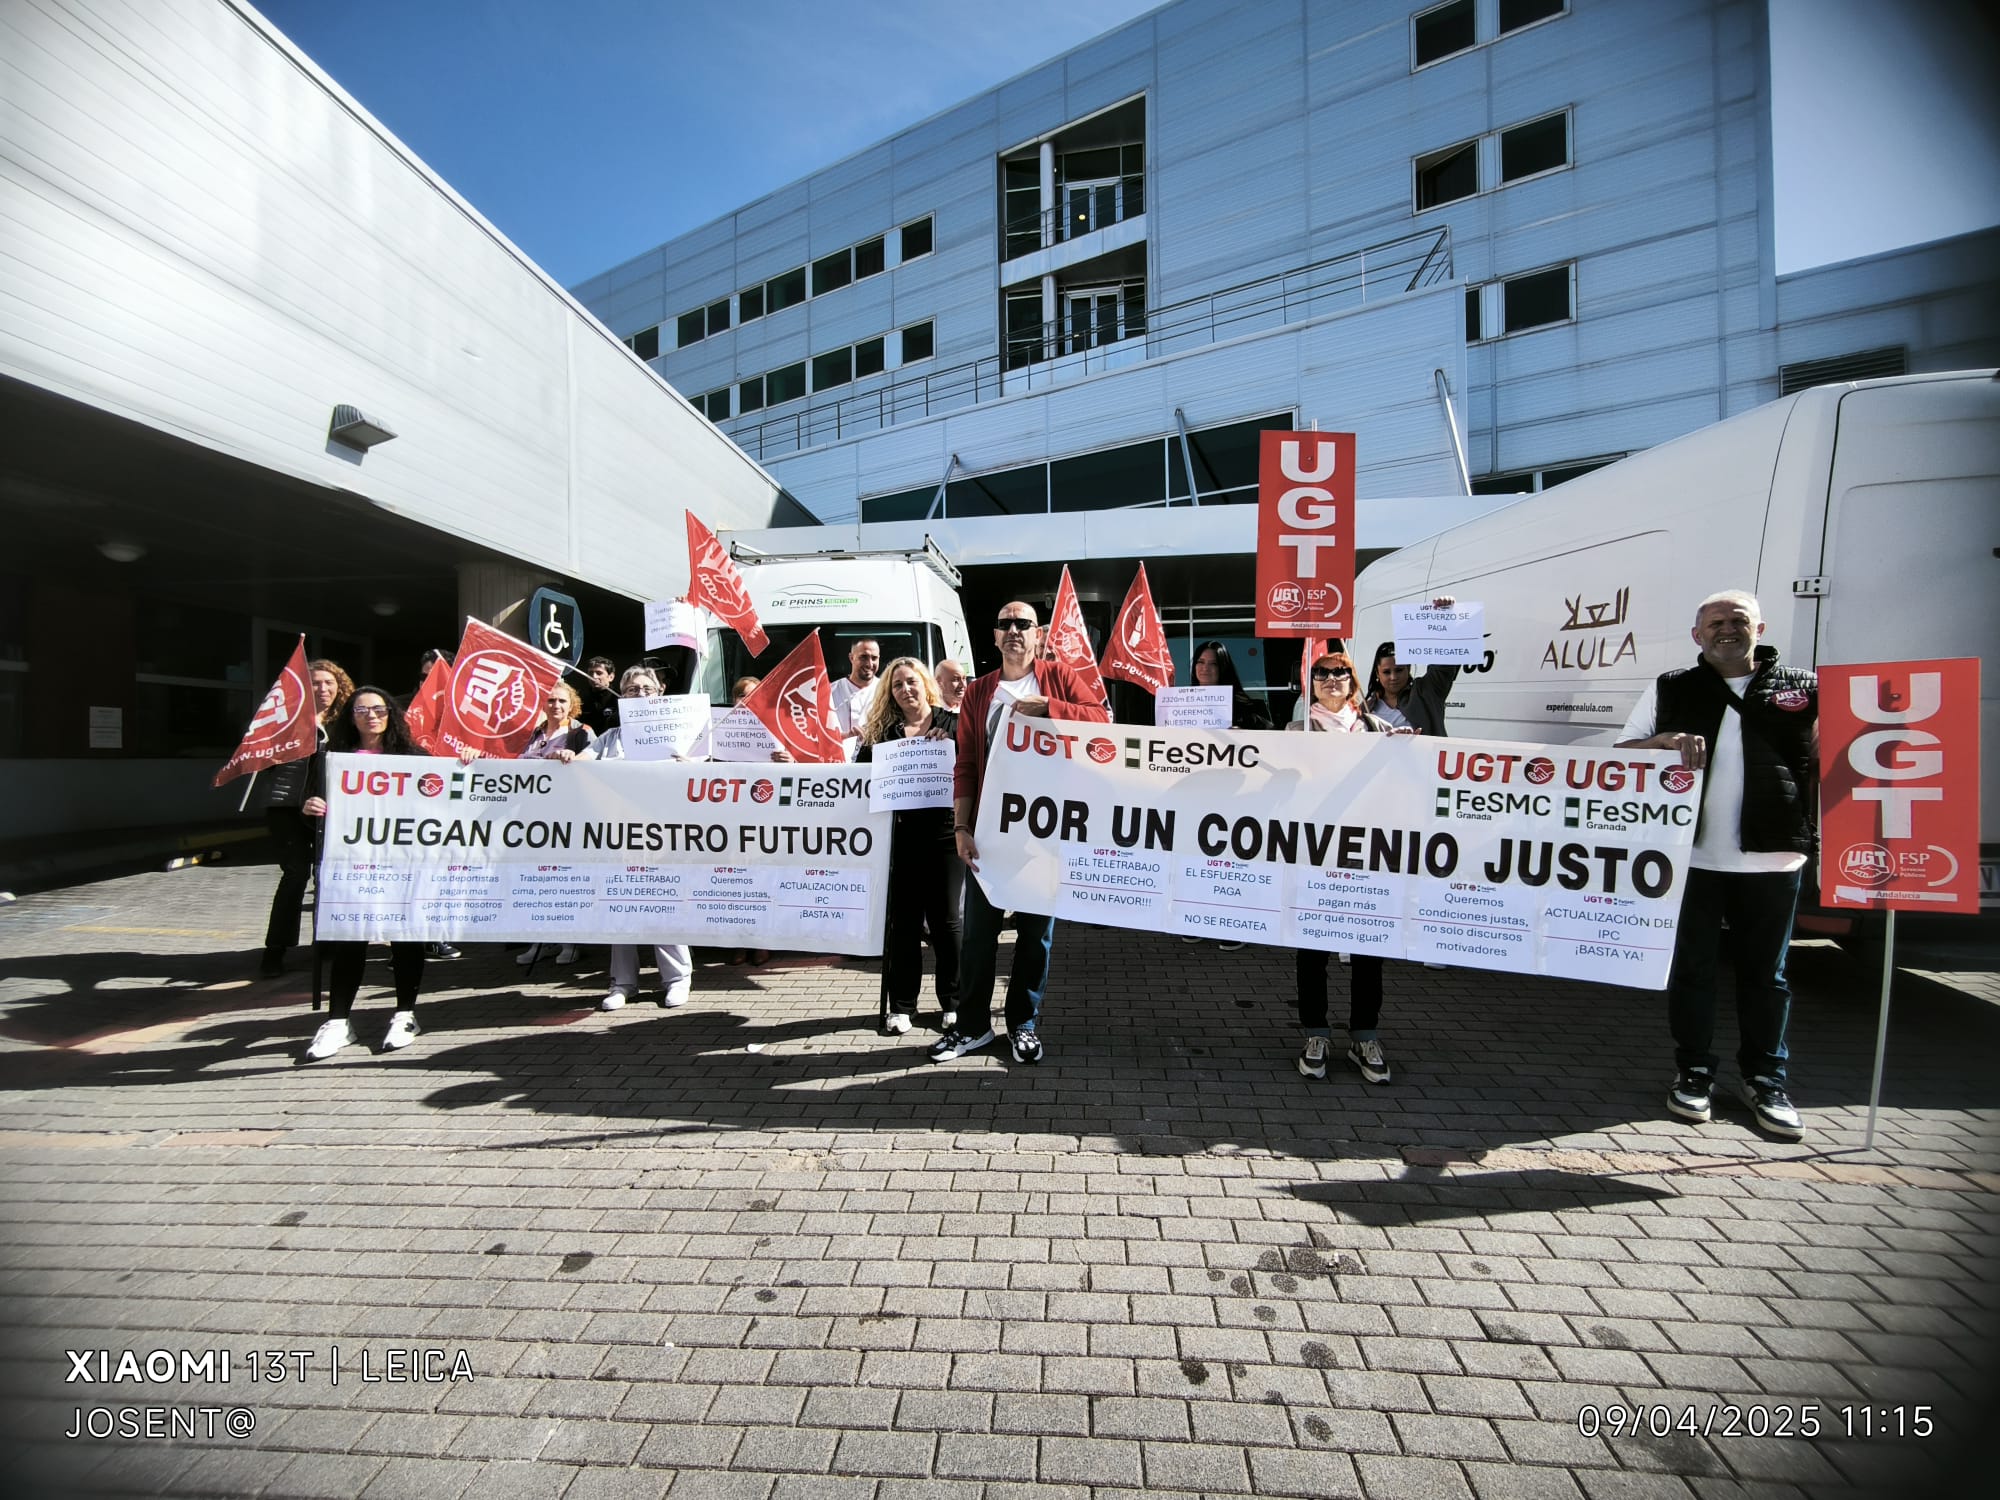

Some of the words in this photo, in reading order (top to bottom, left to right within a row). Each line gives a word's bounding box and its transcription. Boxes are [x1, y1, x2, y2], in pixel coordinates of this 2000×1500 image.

[1277, 441, 1336, 578] UGT
[1273, 588, 1299, 602] UGT
[789, 598, 823, 606] PRINS
[1540, 631, 1637, 671] ALULA
[628, 709, 658, 718] 2320m
[660, 708, 670, 716] ES
[1546, 702, 1613, 713] experiencealula.com
[635, 735, 676, 745] NUESTRO
[725, 731, 767, 739] QUEREMOS
[757, 741, 776, 749] PLUS
[1006, 722, 1079, 760] UGT
[1148, 740, 1260, 768] FeSMC
[900, 749, 947, 758] deportistas
[1848, 672, 1943, 839] UGT
[892, 763, 919, 772] pagan
[1148, 763, 1191, 774] Granada
[1437, 750, 1522, 784] UGT
[1566, 759, 1655, 793] UGT
[341, 770, 412, 796] UGT
[470, 773, 552, 794] FeSMC
[687, 778, 746, 803] UGT
[883, 790, 922, 800] seguimos
[924, 788, 949, 798] igual?
[469, 794, 508, 802] Granada
[1456, 789, 1551, 817] FeSMC
[796, 800, 835, 808] Granada
[1456, 811, 1492, 821] Granada
[1586, 799, 1693, 827] FeSMC
[1586, 821, 1627, 832] Granada
[343, 817, 492, 848] JUEGAN
[502, 820, 572, 849] CON
[583, 822, 728, 853] NUESTRO
[739, 825, 873, 856] FUTURO
[1000, 792, 1090, 843] POR
[1111, 805, 1176, 851] UN
[1197, 813, 1459, 878] CONVENIO
[1484, 838, 1673, 899] JUSTO
[1093, 848, 1110, 856] UGT
[1847, 851, 1886, 867] UGT
[1900, 853, 1930, 865] FSP
[1092, 858, 1160, 873] TELETRABAJO
[333, 873, 343, 881] EL
[347, 873, 399, 882] ESFUERZO
[401, 874, 414, 882] SE
[450, 874, 500, 883] deportistas
[520, 874, 569, 883] Trabajamos
[625, 875, 681, 883] TELETRABAJO
[710, 876, 753, 885] Queremos
[1070, 871, 1083, 880] ES
[1085, 873, 1100, 882] UN
[1103, 874, 1156, 888] DERECHO,
[1186, 867, 1198, 877] EL
[1200, 869, 1256, 883] ESFUERZO
[1259, 875, 1273, 885] SE
[358, 886, 385, 895] PAGA
[440, 888, 468, 897] pagan
[512, 888, 537, 896] cima,
[539, 888, 558, 896] pero
[607, 888, 618, 896] ES
[620, 888, 632, 896] UN
[850, 883, 867, 893] DEL
[1213, 885, 1242, 896] PAGA
[1307, 880, 1326, 890] Los
[1329, 882, 1390, 896] deportistas
[1450, 883, 1468, 891] UGT
[692, 889, 742, 898] condiciones
[1072, 890, 1088, 900] NO
[1091, 893, 1106, 902] UN
[1108, 895, 1152, 907] FAVOR!!!
[815, 896, 829, 904] IPC
[1318, 898, 1350, 909] pagan
[1353, 901, 1377, 911] más
[1444, 893, 1504, 908] Queremos
[1584, 895, 1603, 904] UGT
[609, 905, 623, 913] NO
[624, 905, 637, 913] UN
[640, 905, 675, 913] FAVOR!!!
[727, 903, 767, 912] discursos
[363, 914, 407, 922] REGATEA
[426, 914, 469, 923] seguimos
[471, 914, 497, 923] igual?
[800, 909, 829, 919] ¡BASTA
[831, 911, 844, 920] YA!
[1298, 912, 1322, 921] ¿por
[1347, 916, 1395, 928] nosotros
[1419, 908, 1487, 922] condiciones
[1489, 914, 1529, 927] justas,
[1545, 907, 1650, 927] ACTUALIZACIÓN
[1654, 919, 1674, 929] DEL
[706, 916, 756, 925] motivadores
[1184, 914, 1201, 924] NO
[1203, 916, 1217, 926] SE
[1219, 917, 1267, 931] REGATEA
[1302, 927, 1354, 940] seguimos
[1357, 933, 1389, 944] igual?
[1423, 925, 1437, 933] no
[1440, 926, 1464, 936] solo
[1467, 928, 1523, 942] discursos
[1598, 929, 1620, 941] IPC
[1436, 942, 1507, 957] motivadores
[1576, 944, 1619, 958] ¡BASTA
[1623, 949, 1644, 961] YA!
